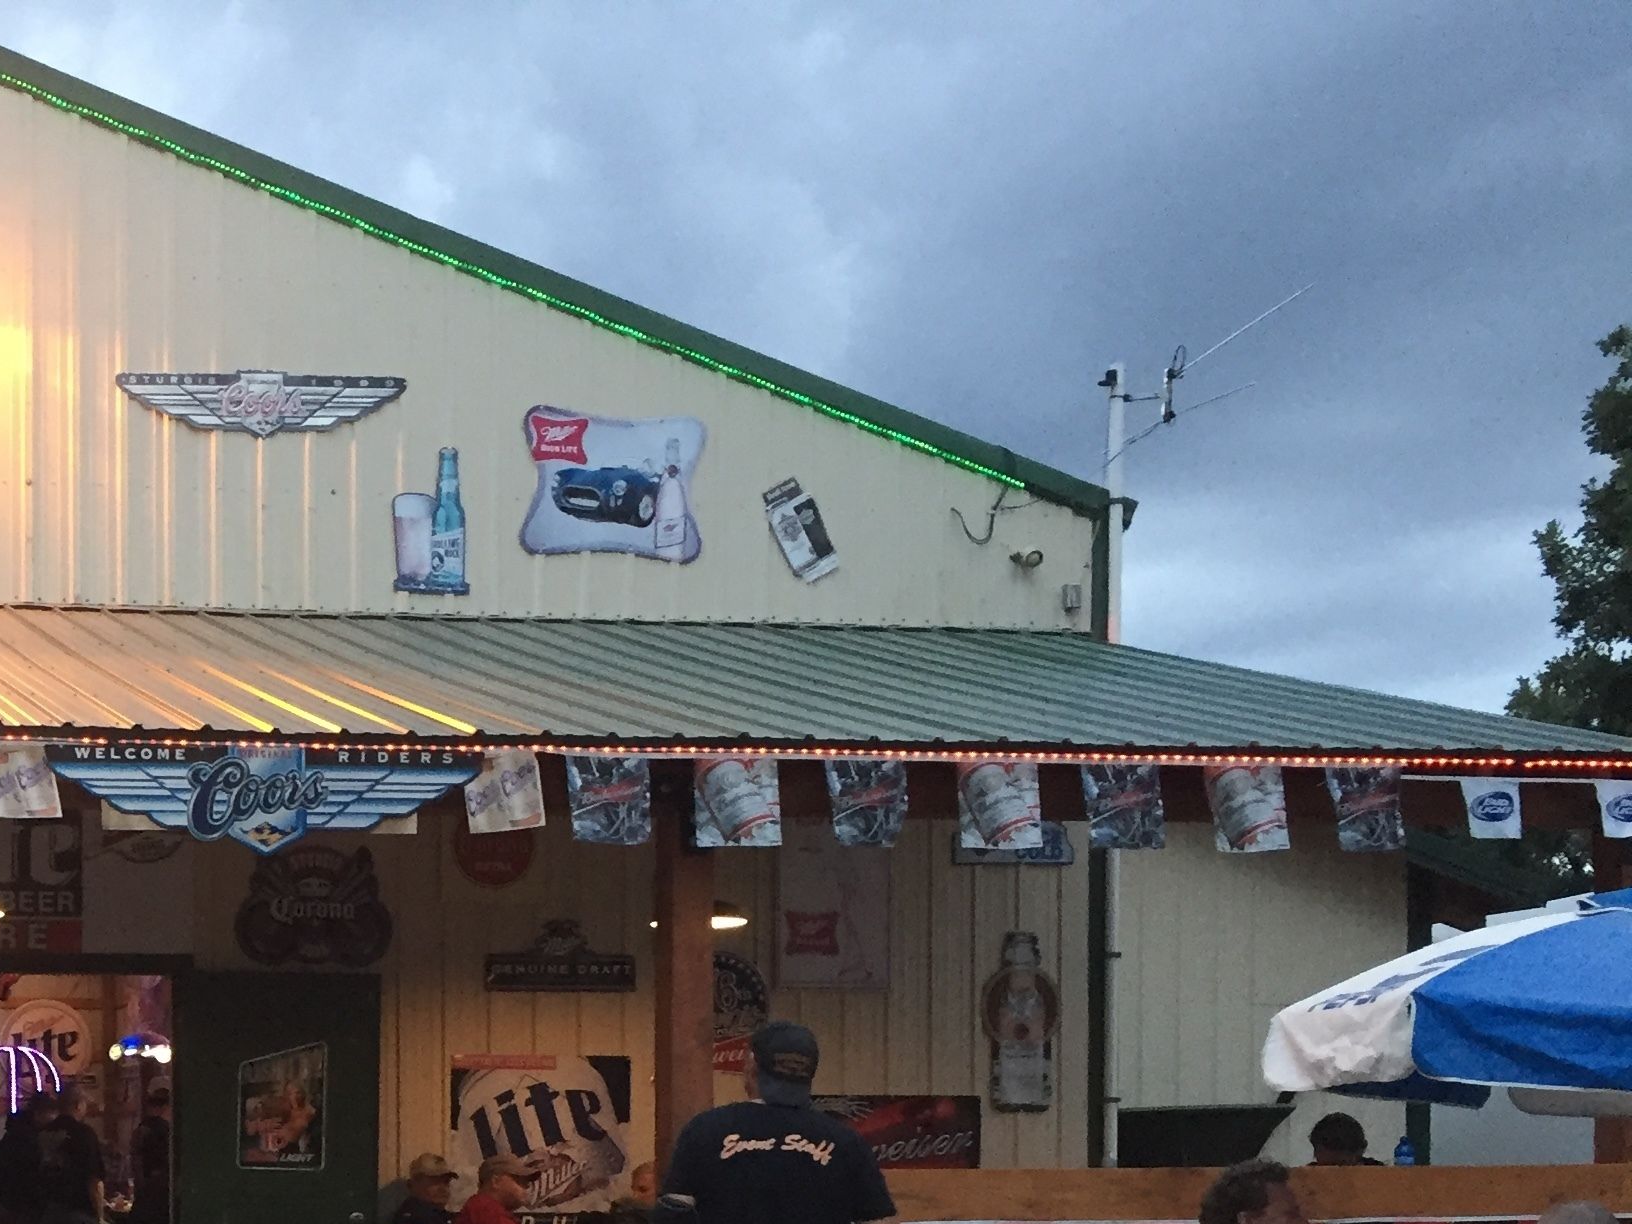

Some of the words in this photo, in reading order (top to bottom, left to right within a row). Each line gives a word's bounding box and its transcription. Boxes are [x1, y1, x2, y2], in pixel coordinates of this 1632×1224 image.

[217, 382, 306, 417] Coors
[74, 746, 188, 762] WELCOME
[337, 749, 456, 765] RIDERS
[185, 753, 330, 842] Coors
[269, 896, 356, 926] Corona
[490, 963, 569, 975] GENUINE
[576, 963, 632, 975] DRAFT
[470, 1082, 608, 1160] lite
[872, 1127, 973, 1161] eiser
